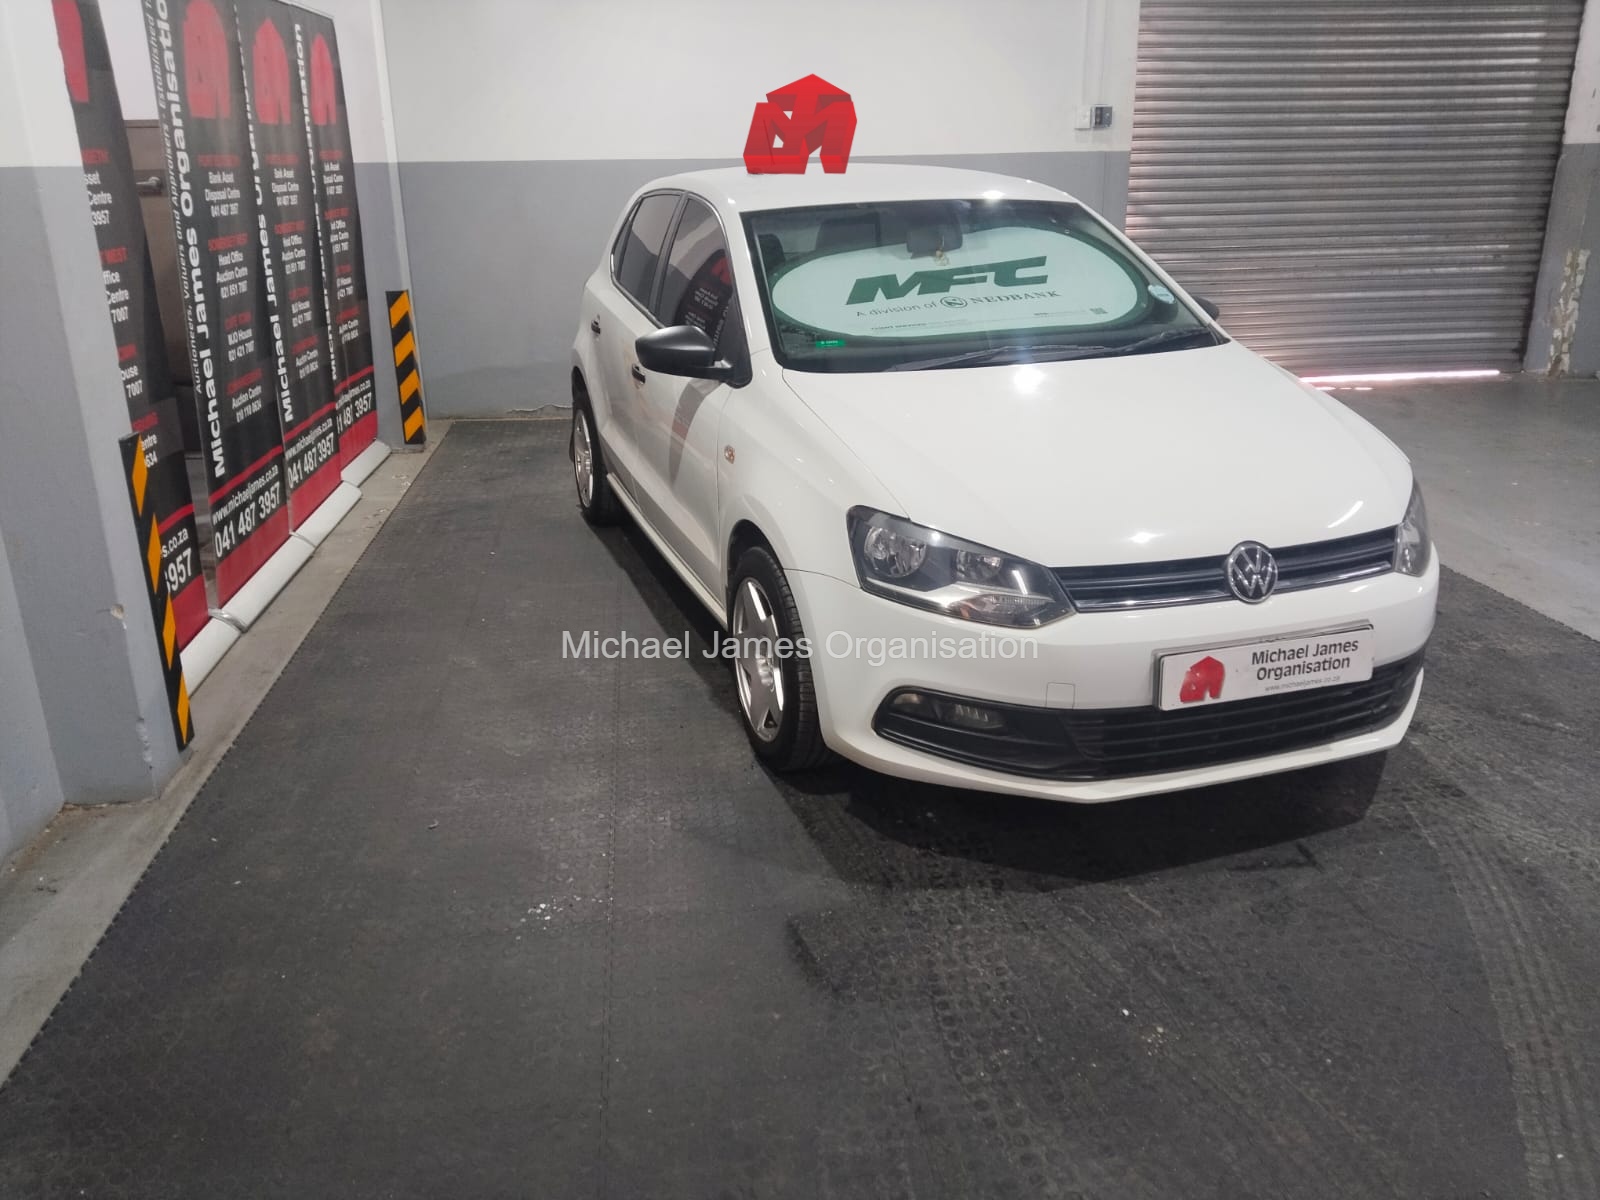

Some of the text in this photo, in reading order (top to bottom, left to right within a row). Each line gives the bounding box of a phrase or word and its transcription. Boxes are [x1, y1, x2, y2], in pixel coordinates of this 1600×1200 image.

[84, 170, 101, 185] sset
[163, 123, 179, 207] Appraisers
[156, 0, 226, 478] Michael James Organisatio
[173, 209, 183, 240] and
[102, 269, 121, 285] ffice
[178, 244, 190, 299] Valuers
[846, 255, 1048, 305] MFC
[869, 304, 920, 316] division
[922, 300, 937, 312] of
[970, 290, 1063, 304] NEDBANK
[258, 214, 294, 422] Michael James
[121, 365, 139, 381] ouse
[354, 392, 372, 418] 3957
[141, 434, 158, 451] entre
[287, 431, 334, 489] 041 487 3957
[214, 481, 280, 558] 041 487 3957
[1251, 639, 1359, 666] Michael James
[1256, 655, 1351, 681] Organisation
